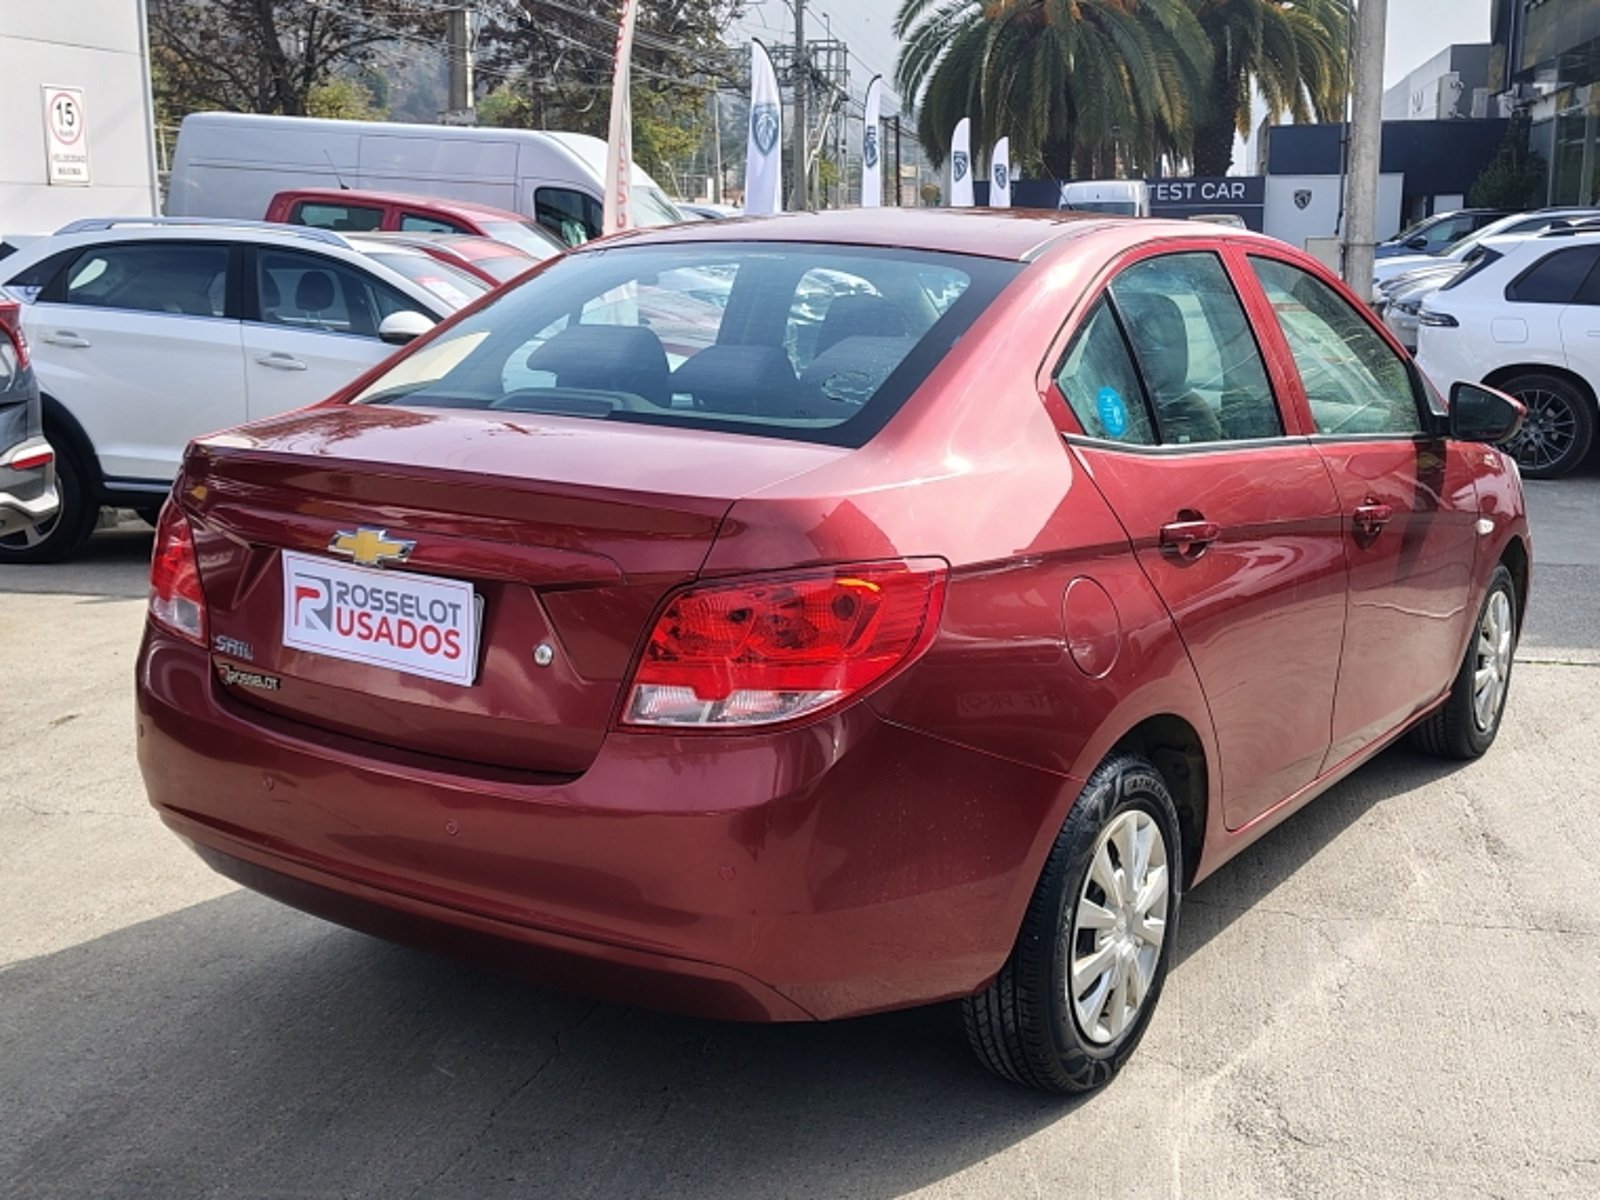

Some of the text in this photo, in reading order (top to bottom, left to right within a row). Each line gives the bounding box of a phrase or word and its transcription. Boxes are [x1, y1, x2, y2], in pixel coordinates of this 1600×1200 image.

[56, 102, 74, 127] 15
[1146, 182, 1245, 200] TEST CAR
[336, 581, 461, 627] ROSSELOT
[336, 607, 461, 660] USADOS
[215, 635, 254, 660] SAIL
